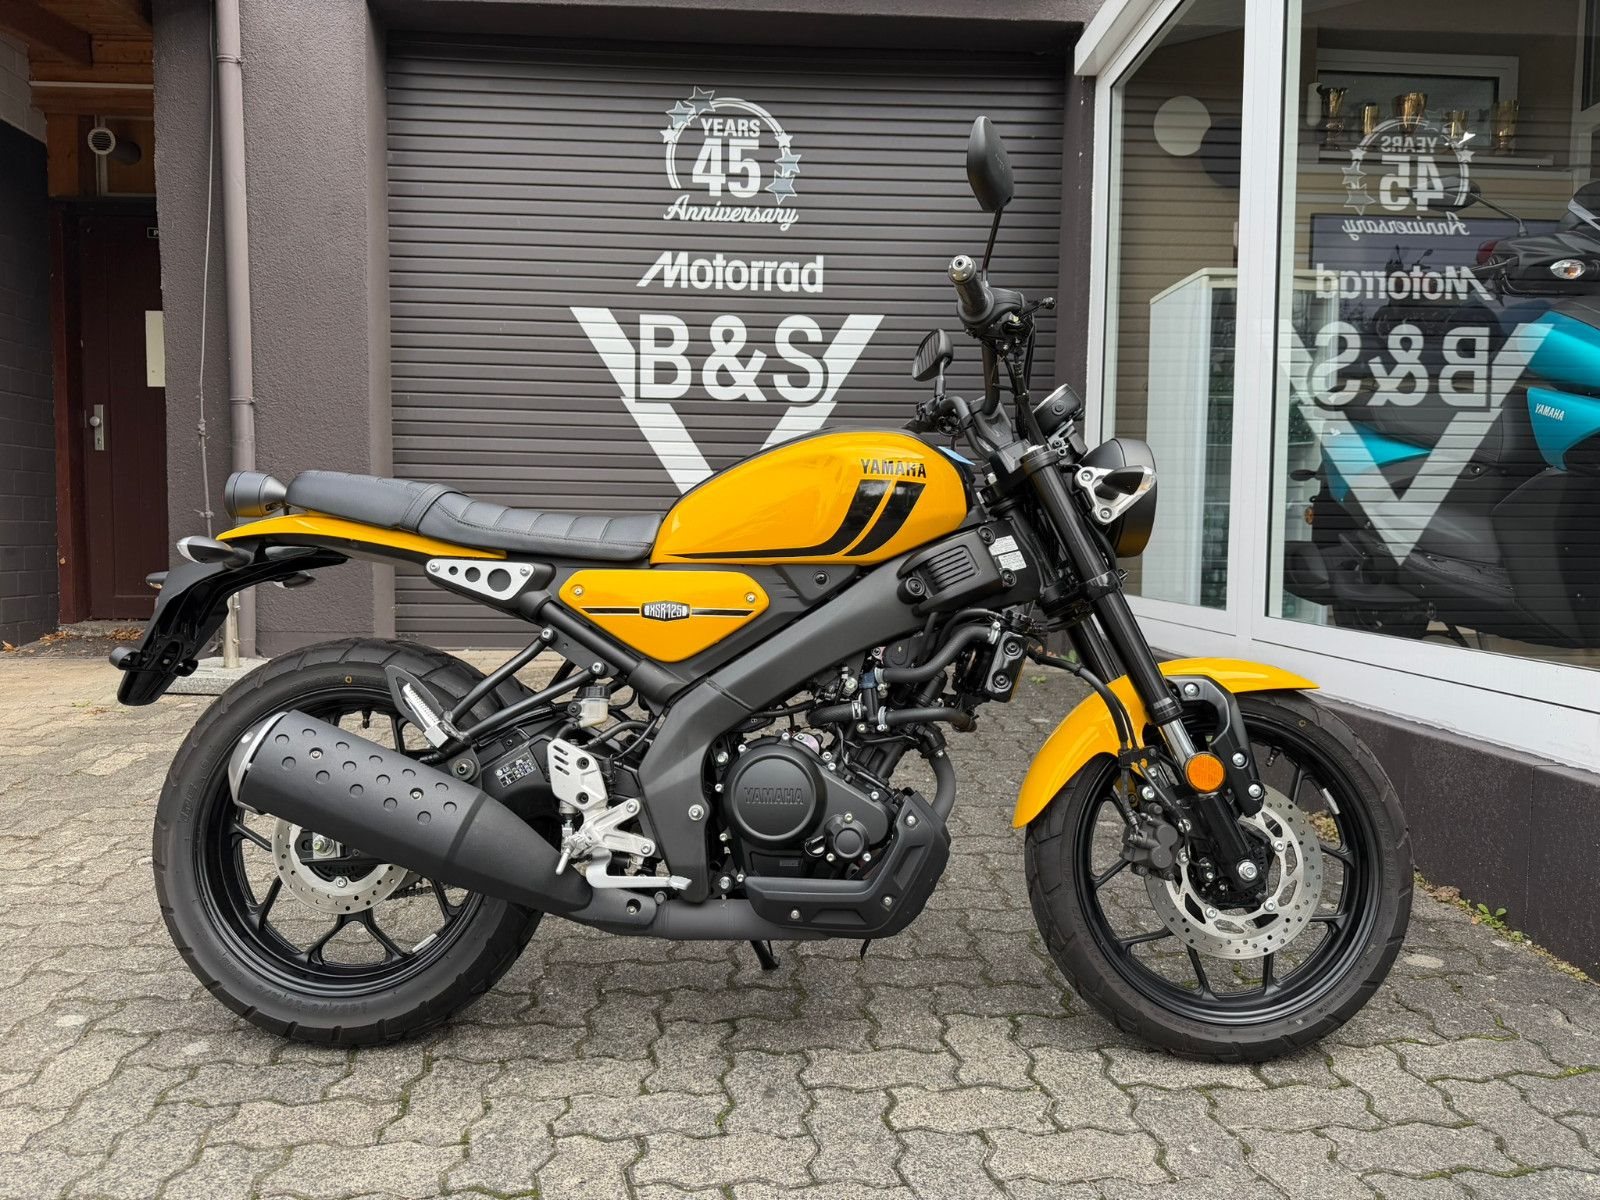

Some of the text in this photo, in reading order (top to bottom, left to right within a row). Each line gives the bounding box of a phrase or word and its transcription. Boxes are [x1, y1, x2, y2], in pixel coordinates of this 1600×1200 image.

[701, 118, 760, 137] YEARS
[692, 138, 761, 198] 45
[663, 194, 799, 231] Anniversary
[636, 251, 824, 293] Motorrad
[639, 314, 824, 402] B&S
[1535, 403, 1565, 421] YAMAHA
[861, 459, 926, 478] YAMAHA
[650, 603, 682, 619] XSR125
[744, 787, 803, 805] YAMAHA
